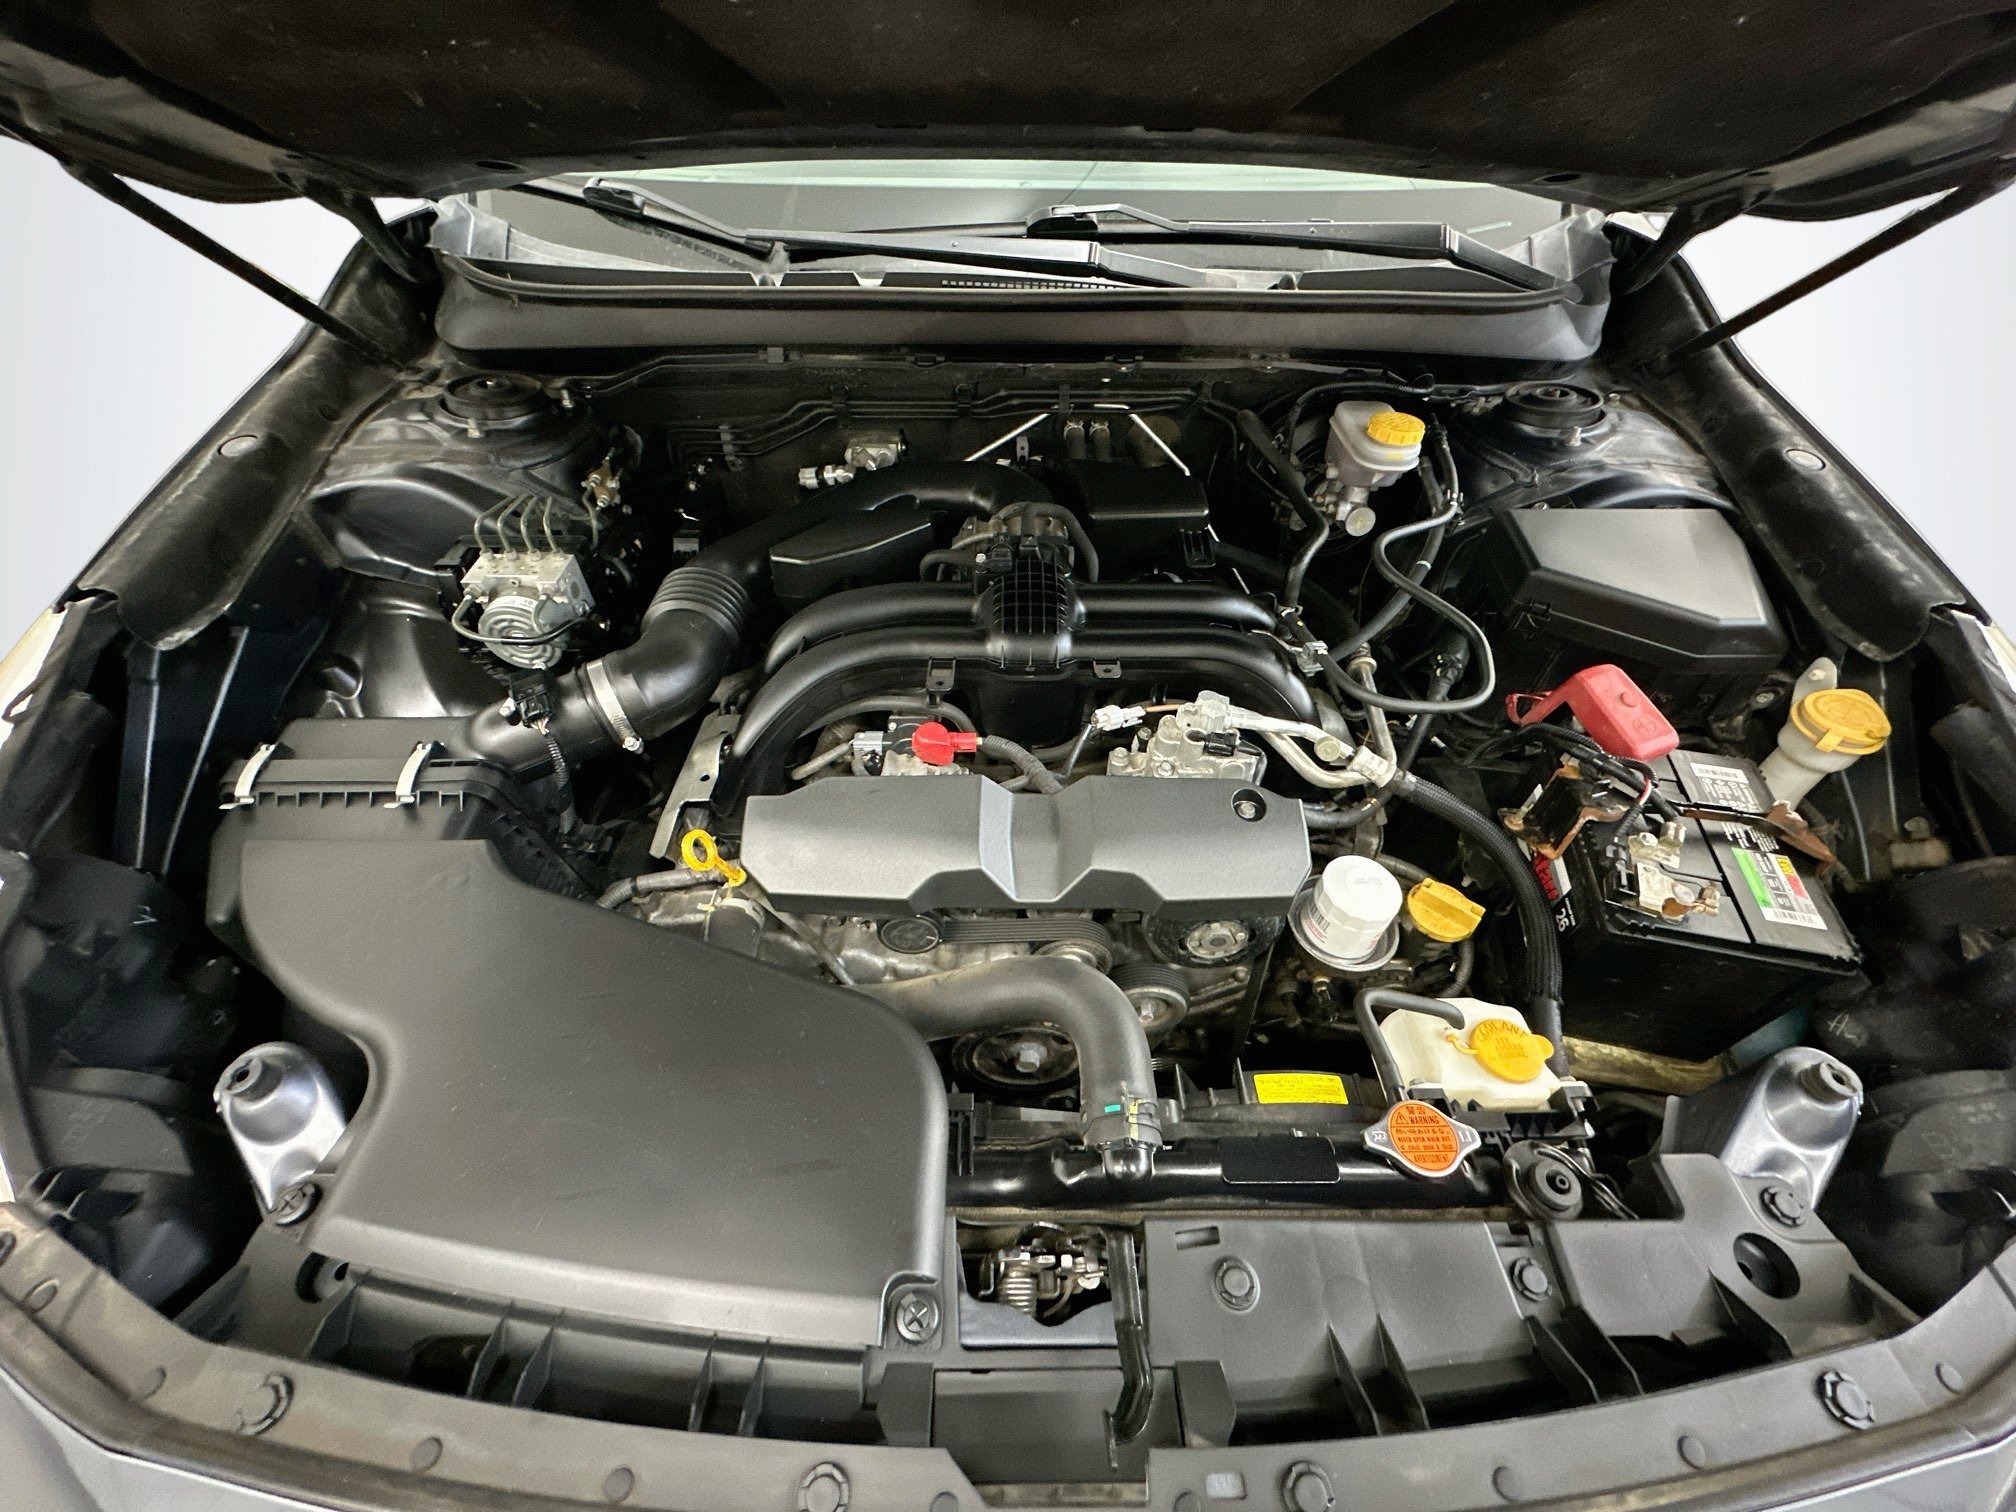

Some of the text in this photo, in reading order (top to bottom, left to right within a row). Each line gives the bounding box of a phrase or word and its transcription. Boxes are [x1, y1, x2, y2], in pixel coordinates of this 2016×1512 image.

[1556, 908, 1570, 932] 26
[1477, 1021, 1529, 1041] COOLANT
[1409, 1116, 1439, 1125] WARNING
